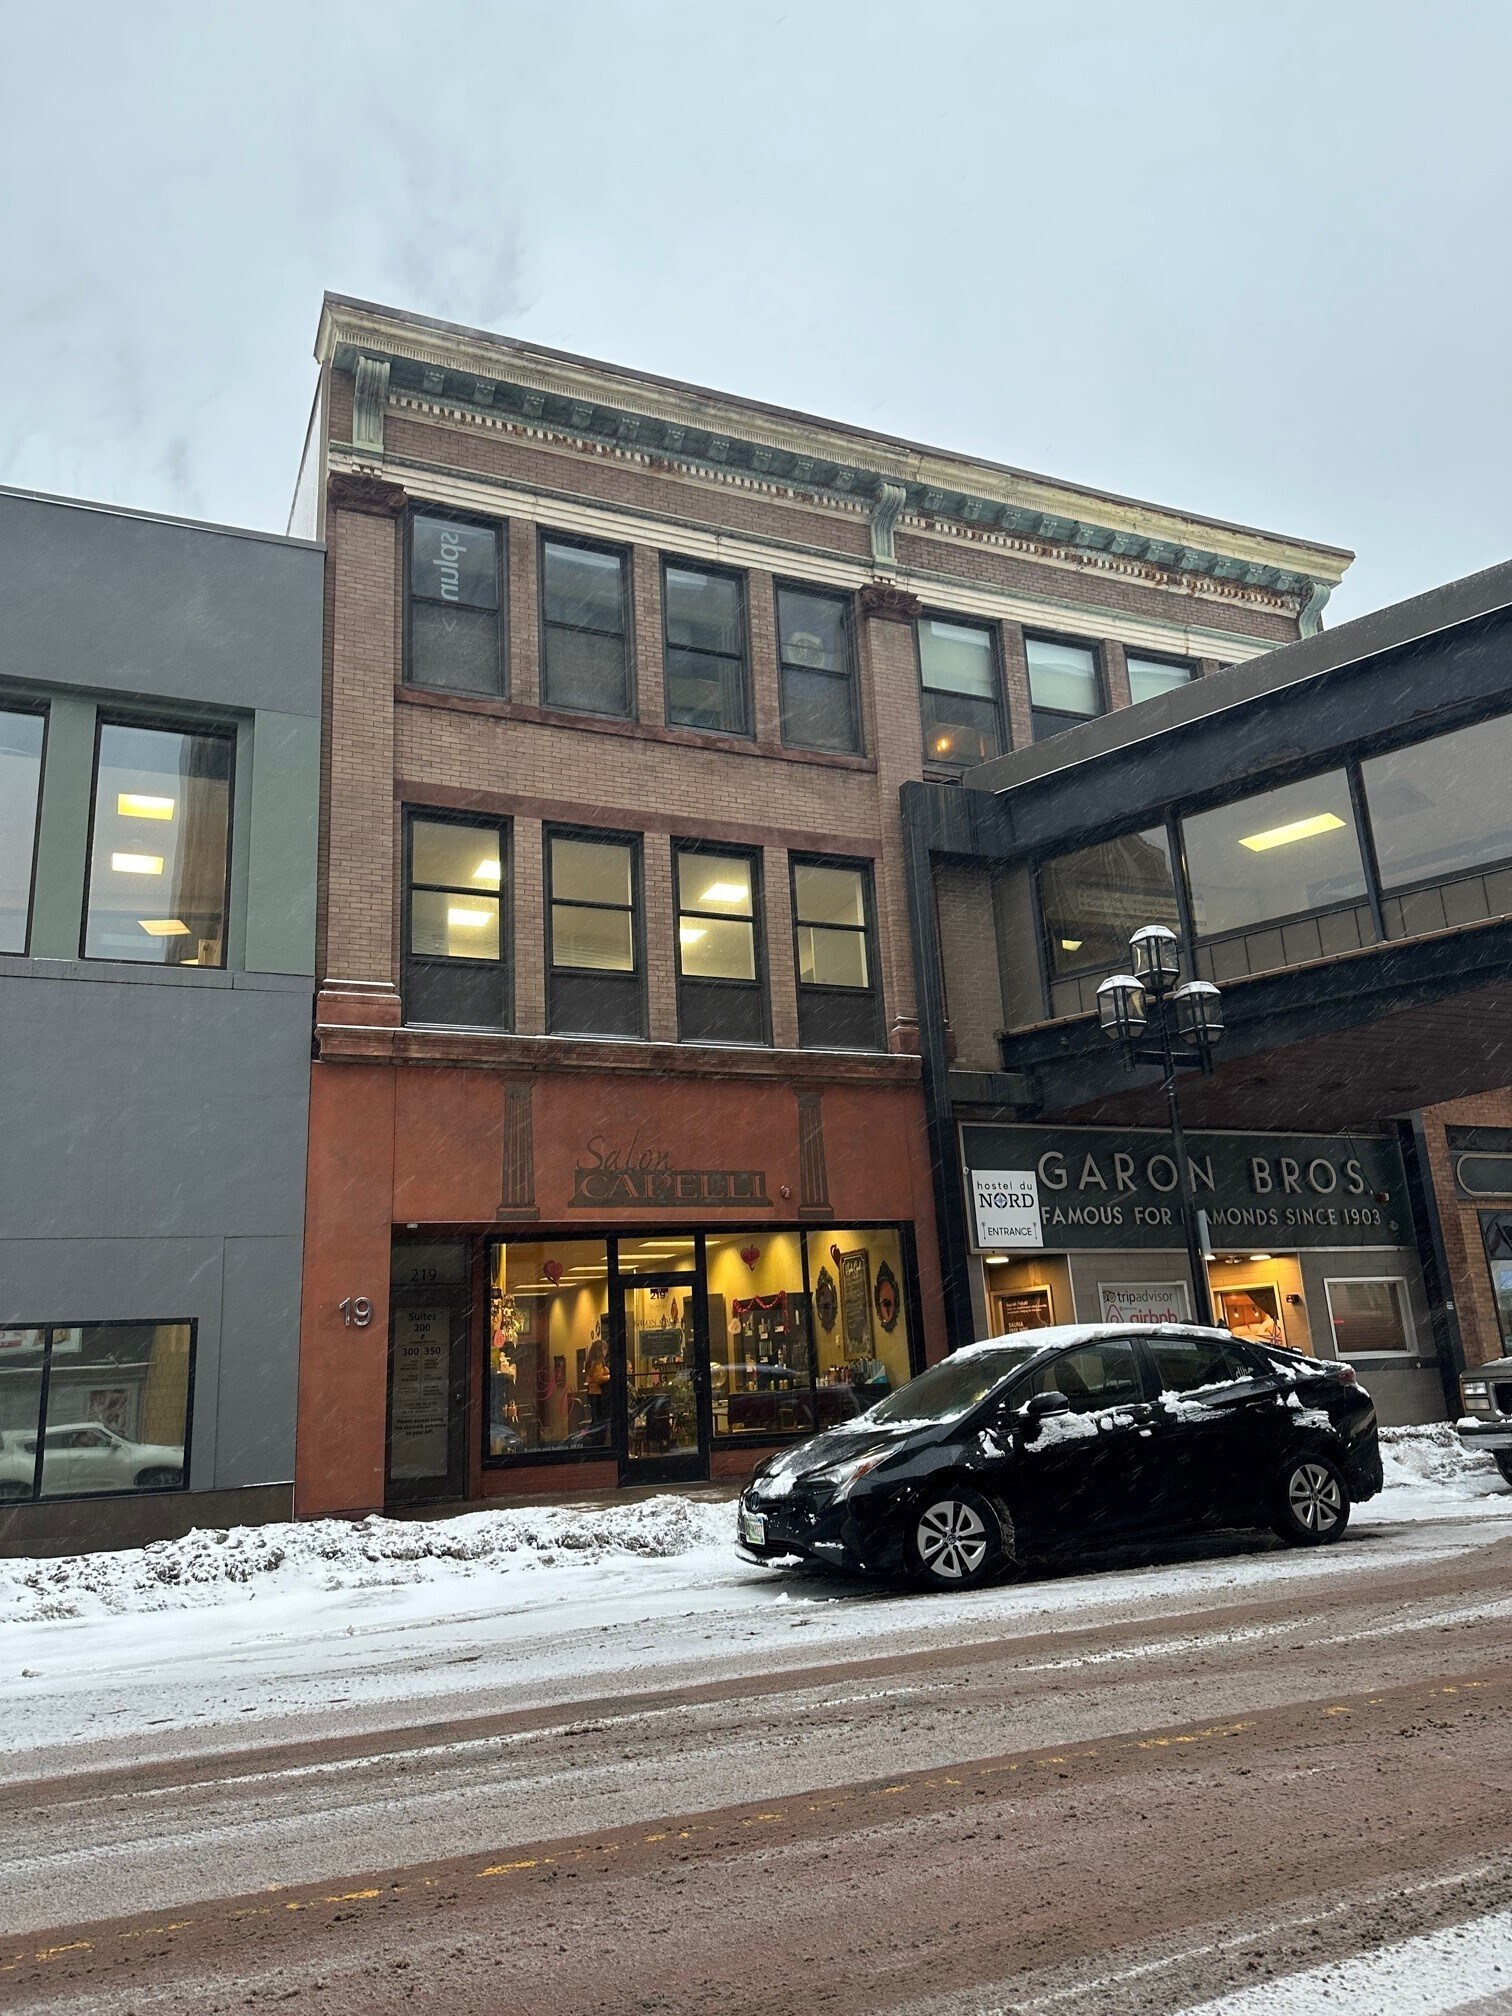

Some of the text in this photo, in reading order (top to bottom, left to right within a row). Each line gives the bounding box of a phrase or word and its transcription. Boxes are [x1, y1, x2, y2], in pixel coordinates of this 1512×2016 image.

[576, 1128, 674, 1171] Salon
[1038, 1151, 1216, 1192] GARON
[579, 1174, 764, 1198] CAPELLI
[977, 1181, 1033, 1190] hostel du
[979, 1192, 1034, 1209] NORD
[1042, 1206, 1382, 1226] FAMOUS FOR AMONDS SINCE 1903
[987, 1227, 1032, 1236] ENTRANCE
[410, 1268, 437, 1281] 219
[650, 1292, 666, 1300] 219
[1117, 1290, 1174, 1305] tripadvisor
[339, 1296, 372, 1327] 19
[408, 1312, 437, 1321] Suites
[1129, 1308, 1178, 1323] airbnb
[414, 1323, 431, 1332] 200
[402, 1346, 441, 1356] 300 350
